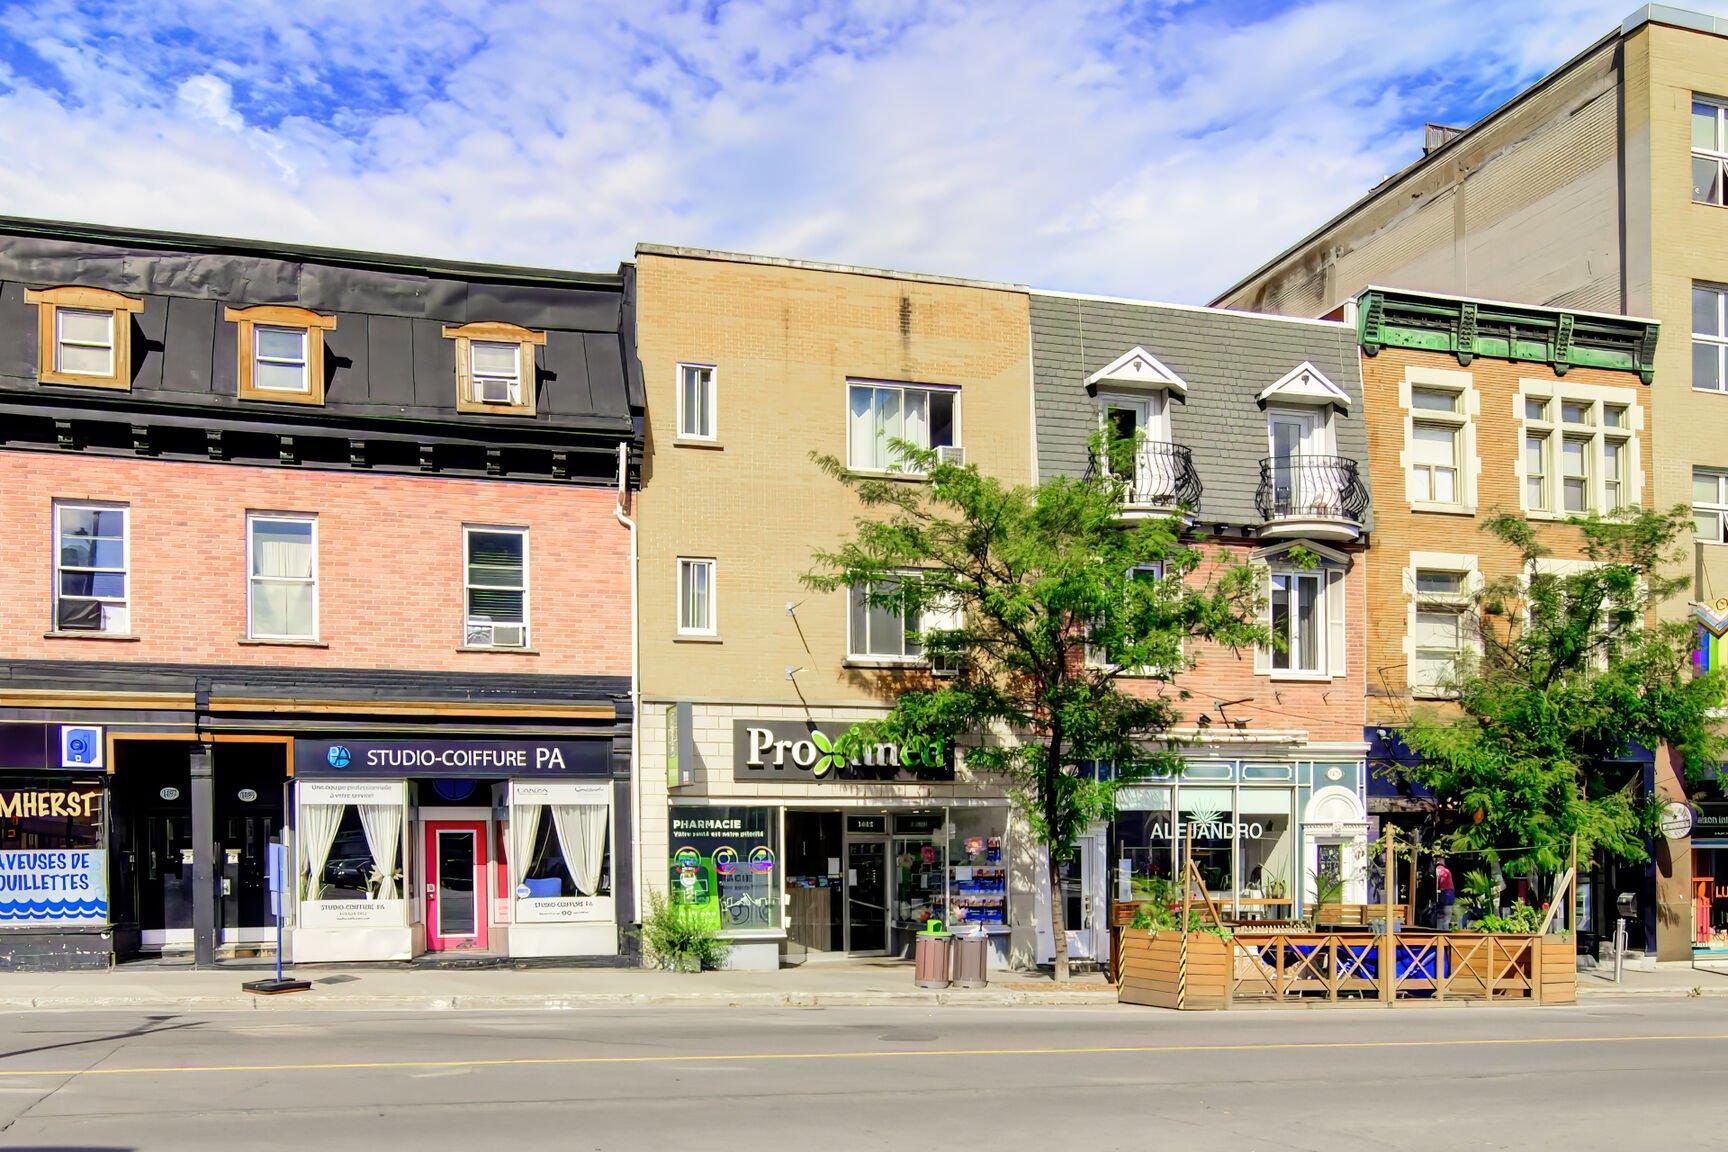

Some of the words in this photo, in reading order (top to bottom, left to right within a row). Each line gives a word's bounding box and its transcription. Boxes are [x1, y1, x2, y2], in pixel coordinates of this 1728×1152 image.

[367, 750, 527, 767] STUDIO-COIFFURE
[536, 747, 566, 769] PA
[673, 820, 741, 829] PHARMACIE
[1150, 822, 1263, 839] ALEJANDRO
[71, 853, 90, 869] DE
